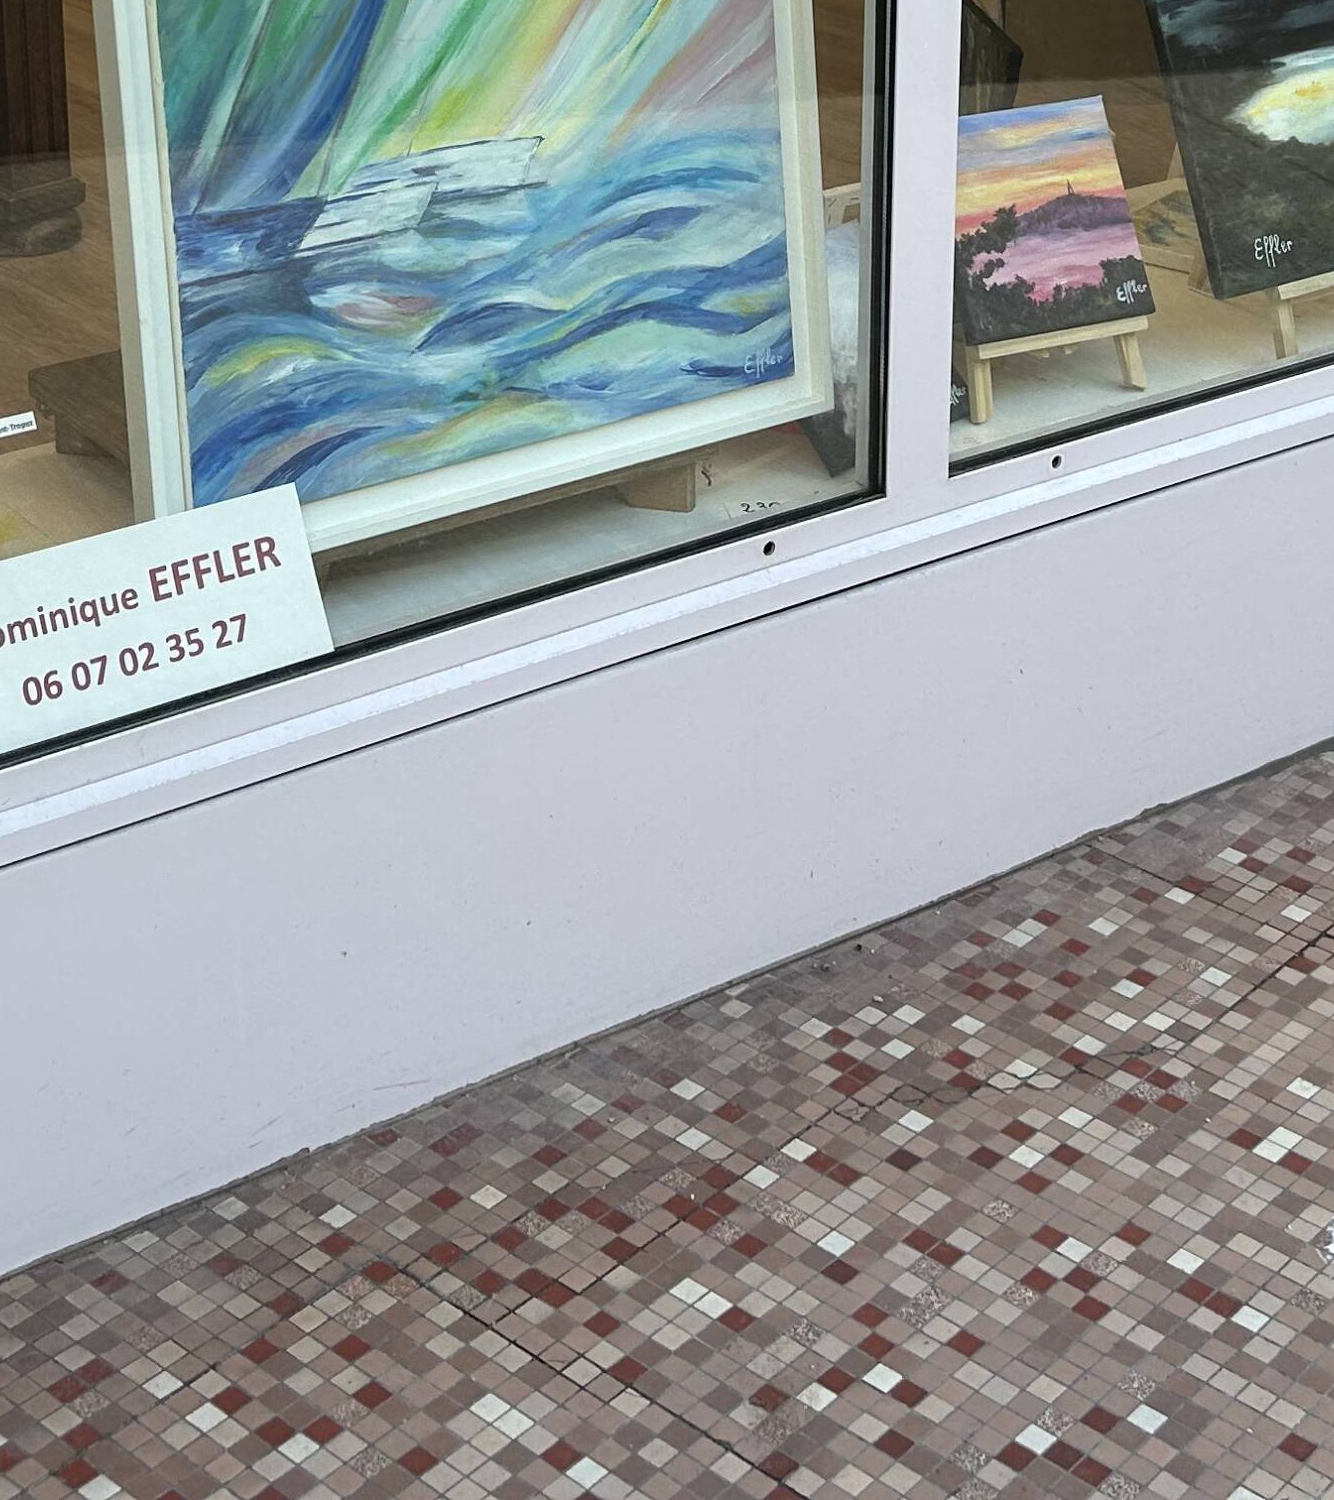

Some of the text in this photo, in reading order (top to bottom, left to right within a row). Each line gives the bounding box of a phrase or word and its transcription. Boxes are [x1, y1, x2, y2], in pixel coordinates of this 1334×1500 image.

[1253, 234, 1294, 267] Effler
[1116, 279, 1148, 304] Effler
[743, 347, 784, 379] Effler
[148, 535, 283, 603] EFFLER
[22, 613, 249, 706] 06 07 02 35 27
